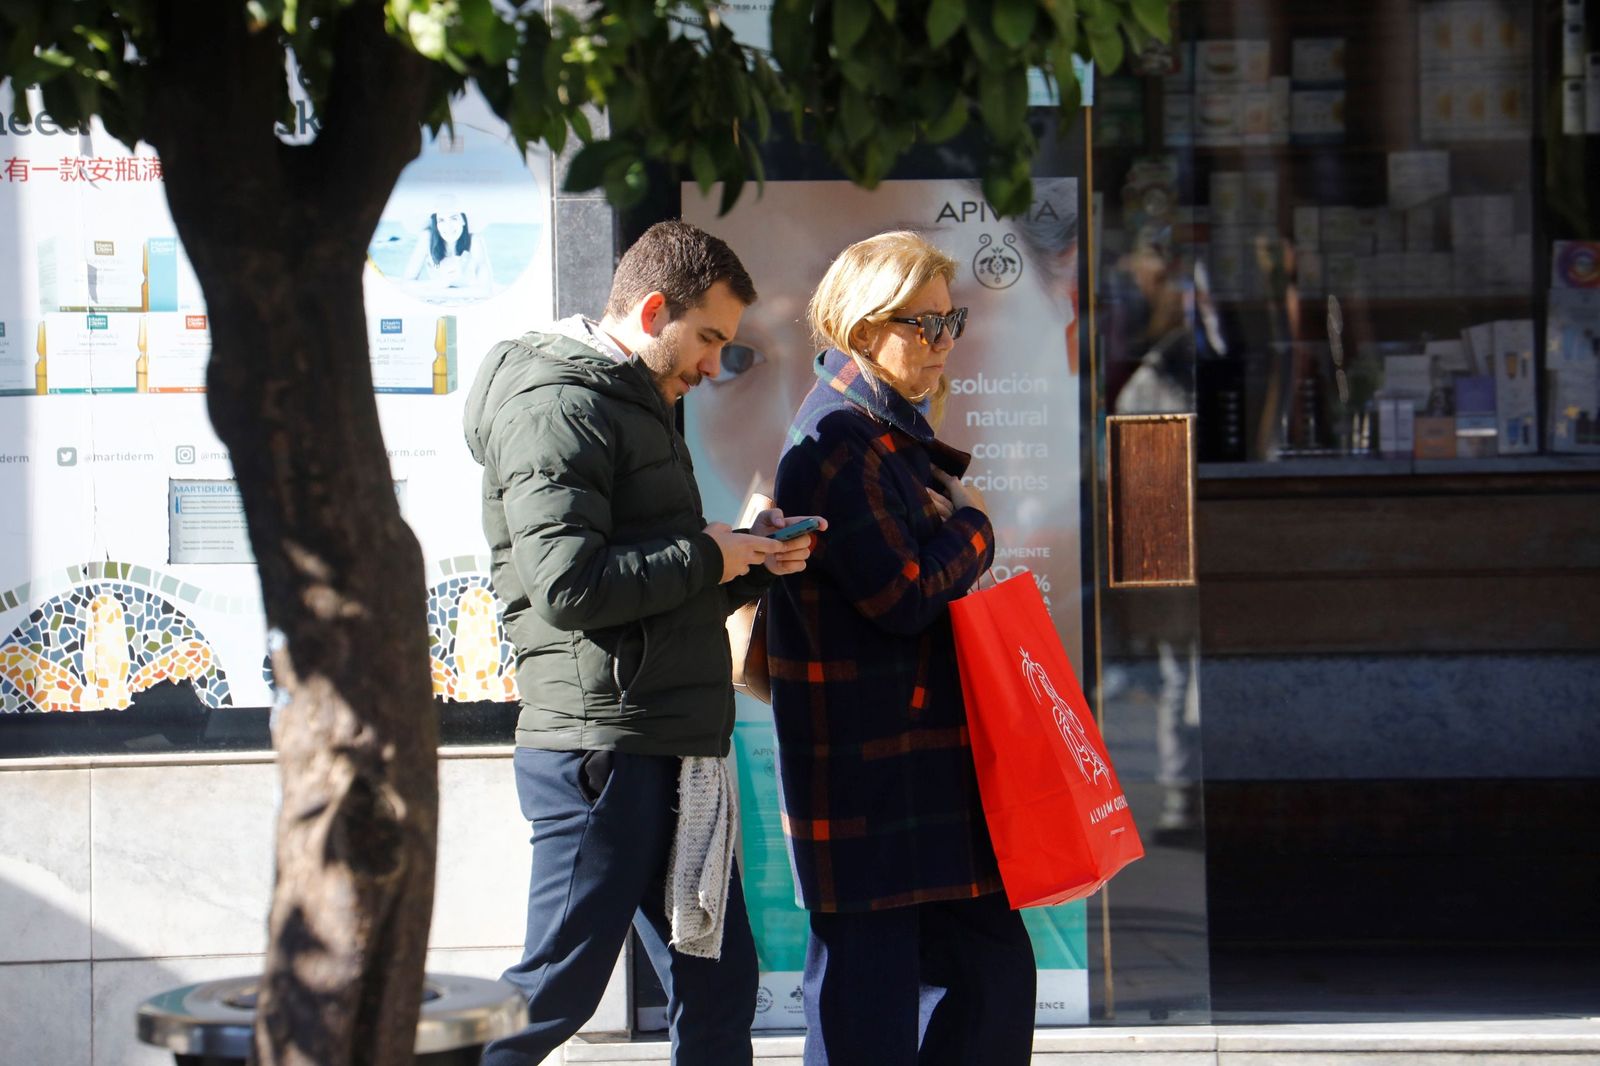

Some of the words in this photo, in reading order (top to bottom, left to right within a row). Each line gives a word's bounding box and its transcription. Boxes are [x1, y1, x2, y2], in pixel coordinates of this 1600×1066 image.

[0, 156, 162, 182] 有一款安瓶满
[950, 372, 1048, 395] solución
[966, 403, 1048, 427] natural
[387, 449, 437, 457] erm.com
[971, 440, 1049, 459] contra
[173, 485, 233, 494] MARTIDERM
[960, 469, 1049, 491] cciones
[995, 547, 1051, 558] AMENTE
